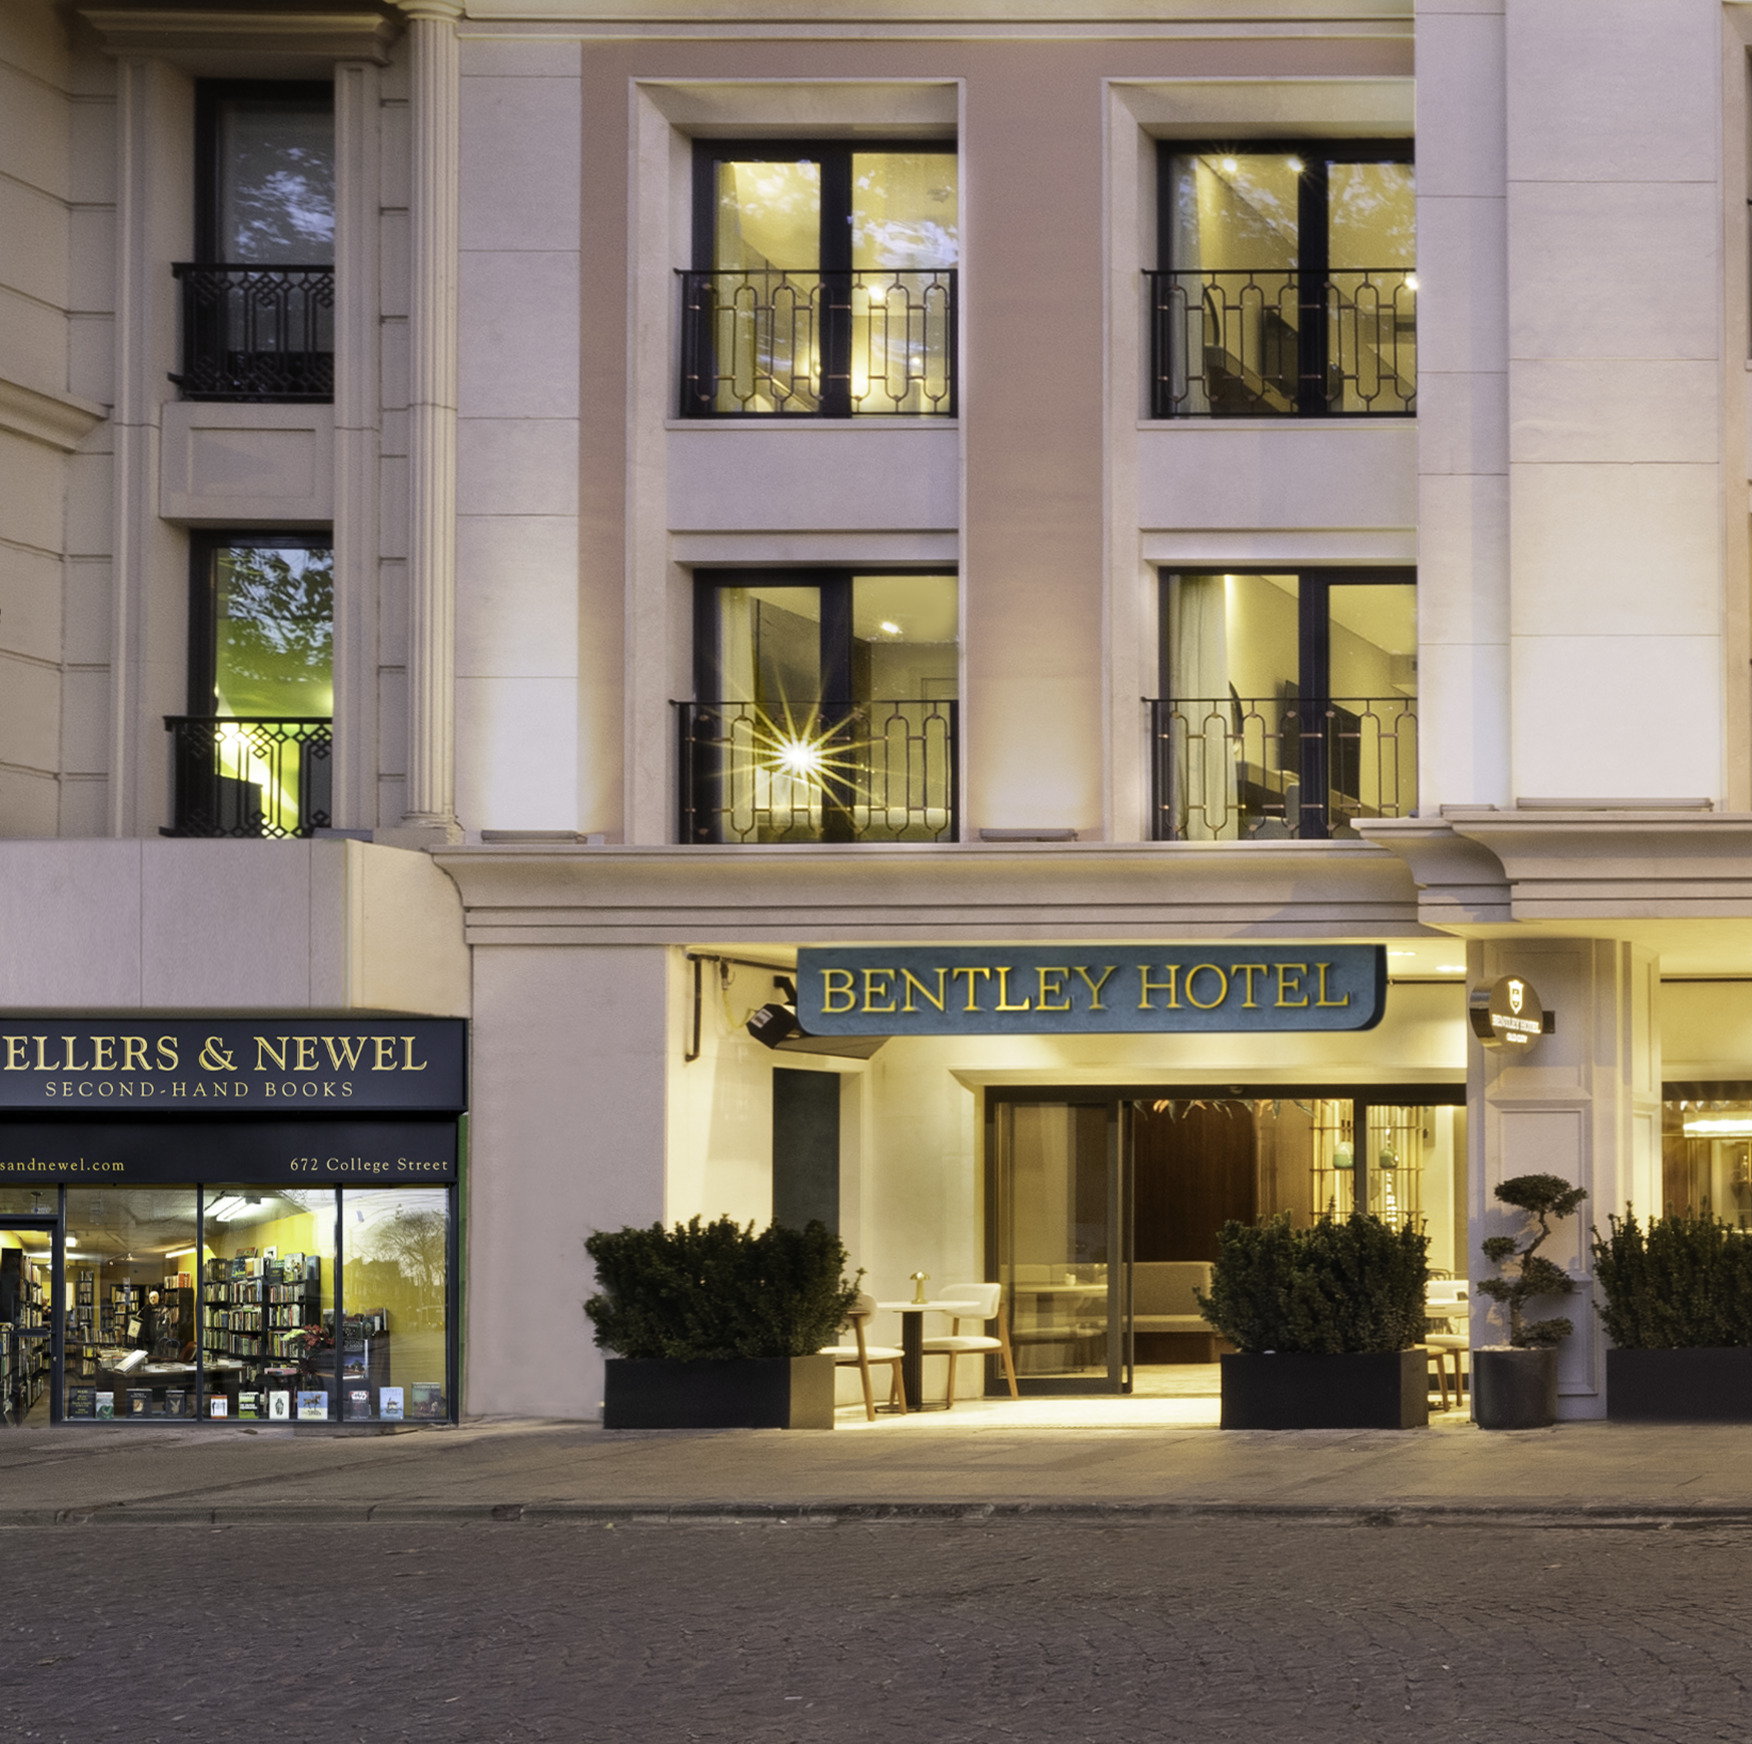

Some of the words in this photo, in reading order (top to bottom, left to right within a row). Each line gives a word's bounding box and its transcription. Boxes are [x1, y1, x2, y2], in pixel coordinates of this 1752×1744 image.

[820, 965, 1117, 1013] BENTLEY
[1136, 962, 1350, 1009] HOTEL
[2, 1035, 179, 1071] ELLERS
[198, 1035, 238, 1072] &
[253, 1036, 428, 1071] NEWEL
[45, 1081, 249, 1098] SECOND-HAND
[264, 1081, 353, 1097] BOOKS
[290, 1157, 319, 1171] 672
[326, 1157, 390, 1174] College
[397, 1157, 448, 1171] Street
